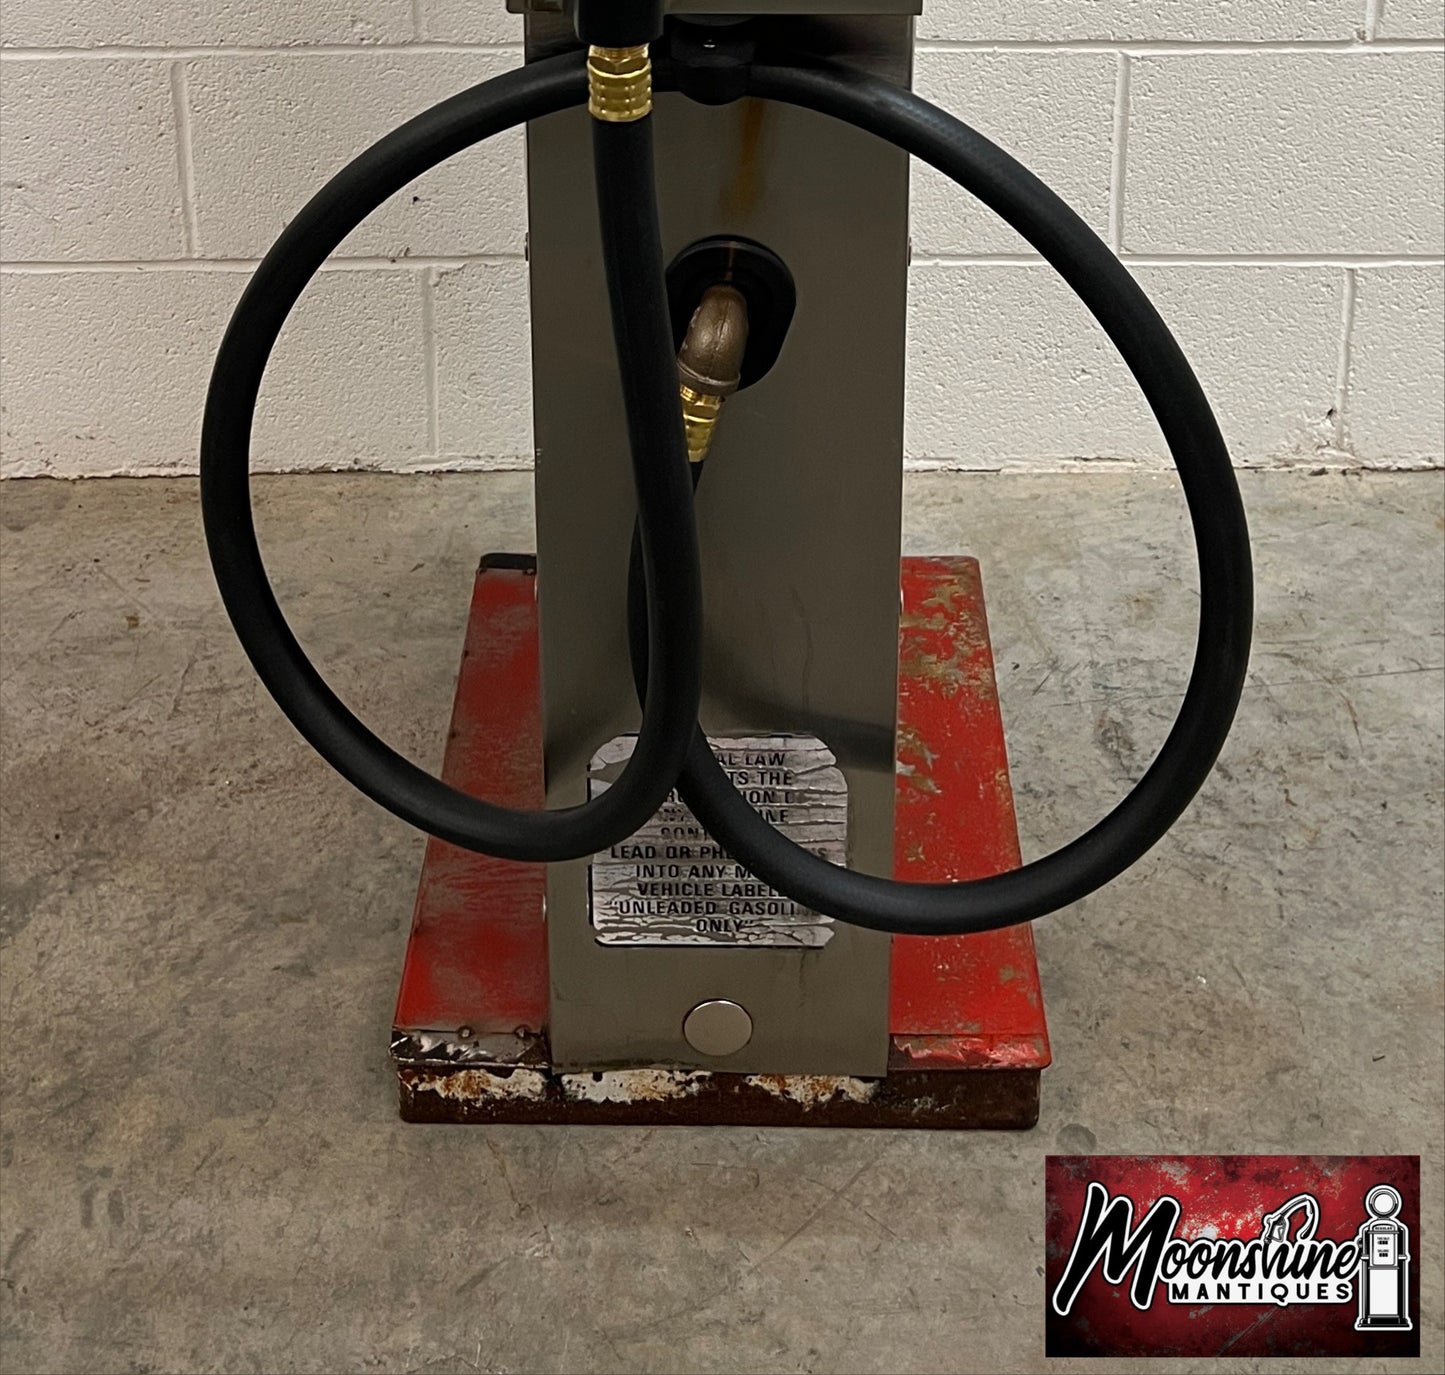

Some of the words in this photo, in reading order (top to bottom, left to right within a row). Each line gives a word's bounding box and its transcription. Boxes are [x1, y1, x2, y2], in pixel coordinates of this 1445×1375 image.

[745, 753, 786, 766] LAW
[759, 771, 792, 785] THE
[610, 846, 656, 859] LEAD
[666, 846, 691, 859] OR
[636, 865, 680, 878] INTO
[689, 865, 726, 878] ANY
[637, 883, 713, 897] VEHICLE
